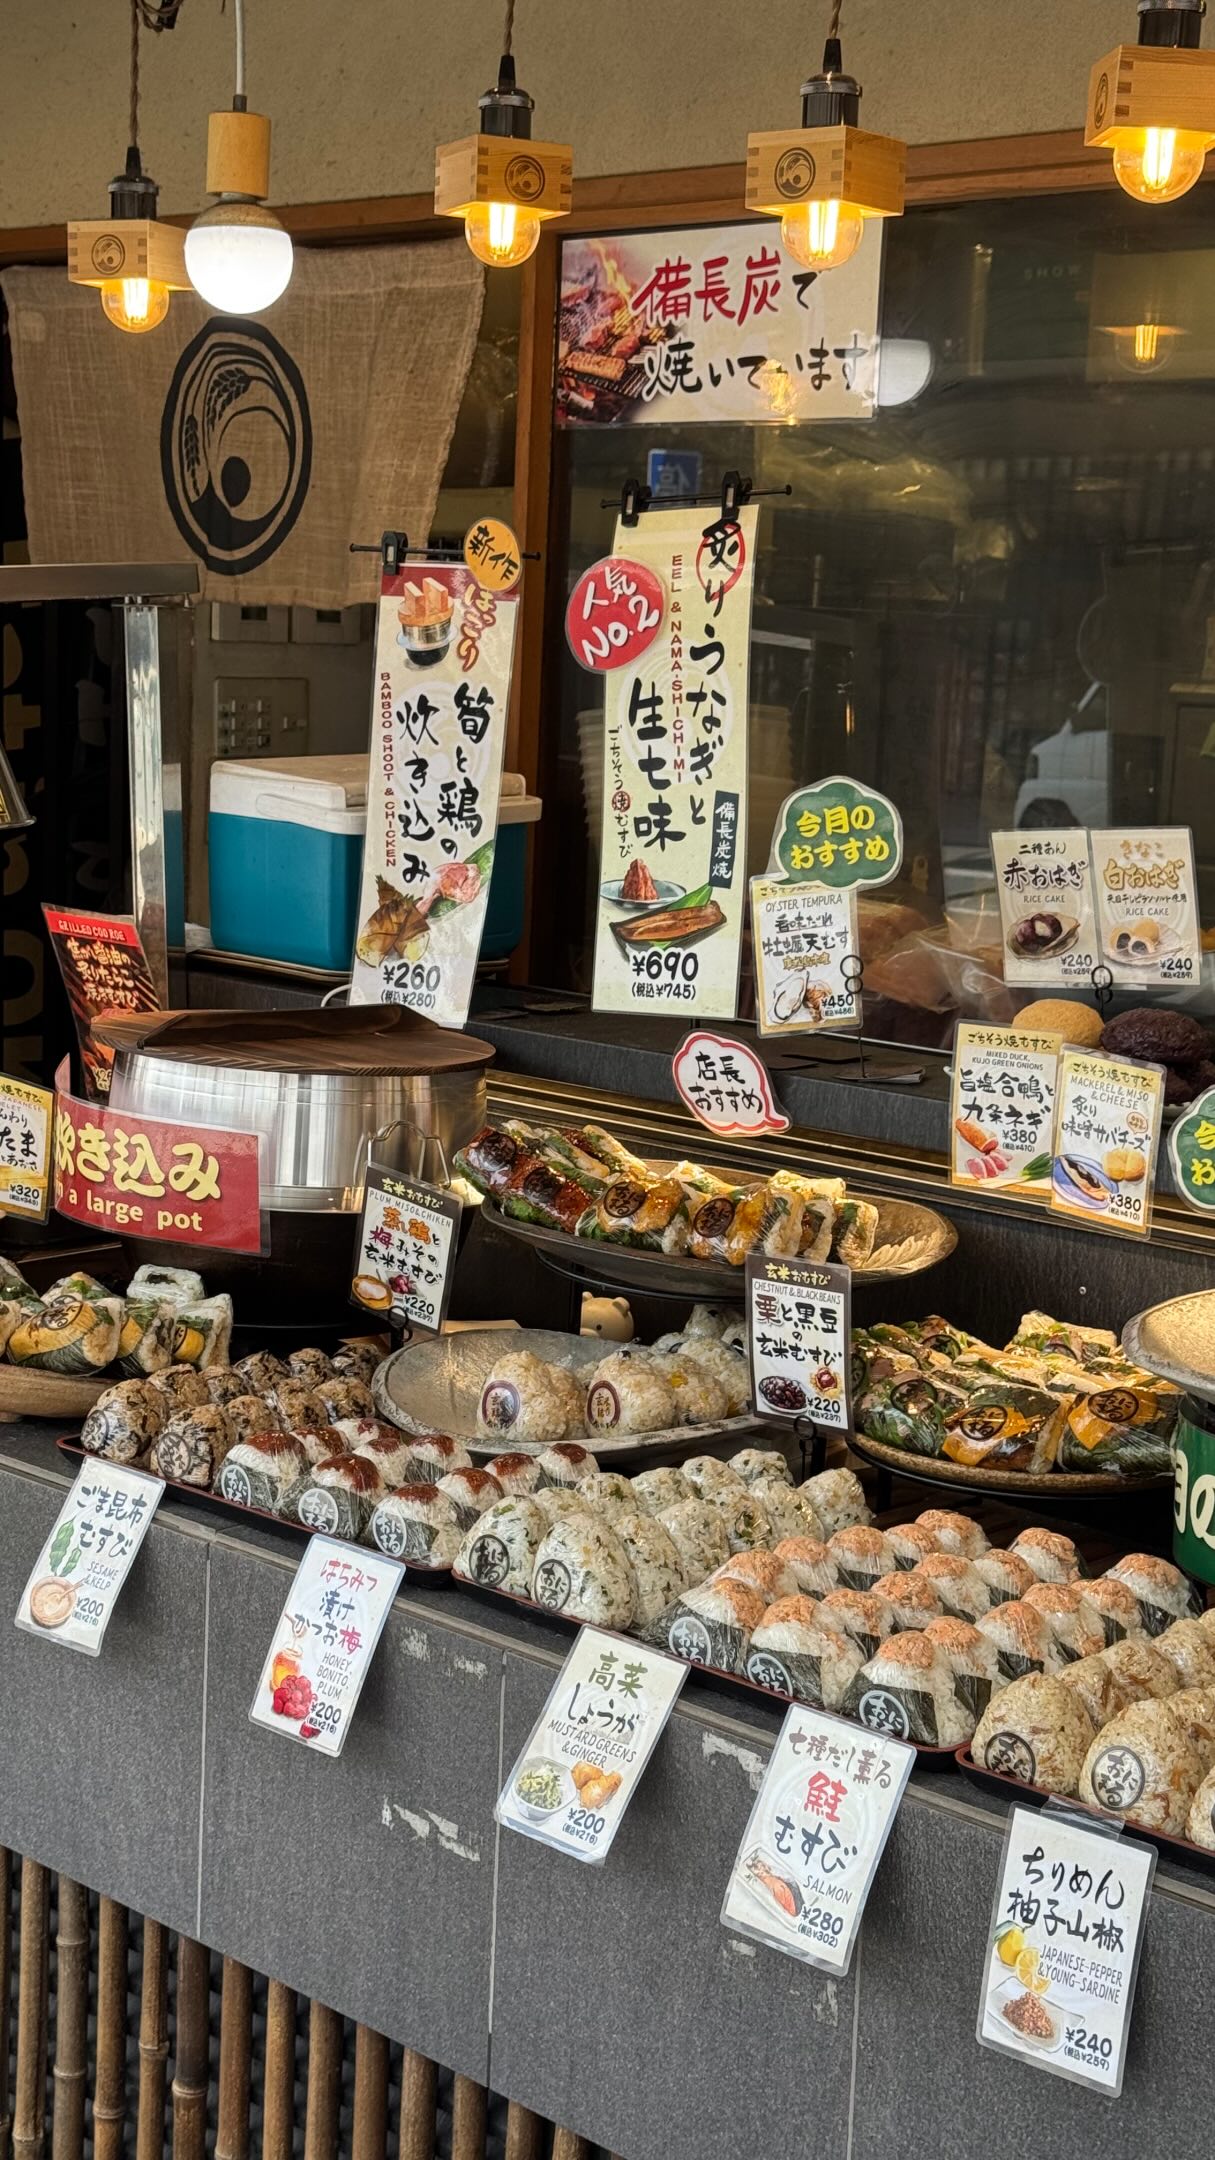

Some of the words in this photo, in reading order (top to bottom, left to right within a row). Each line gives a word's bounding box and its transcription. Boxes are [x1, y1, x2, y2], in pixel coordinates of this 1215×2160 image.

[467, 525, 519, 581] 新作
[671, 554, 683, 593] EEL
[582, 565, 637, 620] 人気
[671, 602, 682, 613] &
[457, 583, 497, 672] ほっこり
[686, 519, 741, 825] 炙りうなぎと
[380, 672, 394, 729] BAMBOO
[671, 620, 685, 783] NAMA-SHICHIMI
[382, 734, 395, 781] SHOOT
[437, 682, 494, 859] 筍と鶏の
[629, 677, 687, 852] 生七味
[384, 787, 395, 796] &
[396, 693, 441, 883] 炊き込み
[384, 801, 397, 867] CHICKEN
[796, 804, 876, 837] 今月の
[712, 801, 736, 880] 備長炭焼
[790, 837, 891, 870] おすすめ
[1018, 842, 1066, 855] 二種あん
[1120, 840, 1164, 859] きなこ
[1002, 858, 1086, 889] 赤おはぎ
[1103, 858, 1185, 890] 白おはぎ
[766, 898, 799, 913] OYSTER
[802, 893, 843, 909] TEMPURA
[1023, 895, 1042, 904] RICE
[1045, 895, 1066, 904] CAKE
[1125, 907, 1145, 917] RICE
[1147, 907, 1169, 916] CAKE
[58, 919, 92, 936] GRILLED
[92, 926, 109, 939] COD
[109, 929, 125, 941] ROE
[76, 960, 135, 988] 炙りたらこ
[382, 961, 441, 992] ¥260
[632, 951, 699, 982] ¥690
[1061, 954, 1093, 968] ¥240
[1160, 958, 1193, 971] ¥240
[631, 982, 697, 1000] (税込¥745)
[821, 994, 854, 1009] ¥450
[695, 1051, 746, 1085] 店長
[972, 1057, 990, 1066] KUJO
[991, 1058, 1016, 1068] GREEN
[1016, 1061, 1043, 1071] ONIONS
[986, 1050, 1008, 1059] MIXED
[688, 1081, 763, 1114] おすすめ
[960, 1068, 1055, 1104] 旨塩合鴨と
[1070, 1075, 1116, 1094] MACKEREL
[1117, 1087, 1125, 1096] &
[1126, 1088, 1149, 1102] MISO
[961, 1096, 1052, 1130] 九条ネギ
[1072, 1095, 1097, 1117] 炙り
[1002, 1129, 1037, 1145] ¥380
[1061, 1115, 1151, 1152] 味噌サバチーズ
[10, 1184, 40, 1200] ¥320
[381, 1177, 444, 1209] 玄米おむすび
[1109, 1193, 1142, 1212] ¥380
[69, 1188, 78, 1205] a
[86, 1189, 144, 1224] large
[157, 1209, 203, 1232] pot
[370, 1225, 440, 1268] 梅みその
[364, 1243, 443, 1285] 玄米むすび
[765, 1262, 832, 1286] 玄米おむすび
[405, 1295, 435, 1315] ¥220
[754, 1281, 789, 1296] CHESTNUT
[789, 1287, 795, 1297] &
[797, 1287, 819, 1301] BLACK
[819, 1292, 841, 1305] BEANS
[755, 1293, 838, 1334] 栗と黒豆
[755, 1332, 842, 1366] 玄米むすび
[792, 1331, 803, 1342] の
[807, 1397, 841, 1413] ¥220
[77, 1485, 148, 1529] ごま昆布
[80, 1519, 134, 1558] むすび
[378, 1533, 400, 1552] まる
[87, 1560, 119, 1581] SESAME
[320, 1557, 378, 1593] はちみつ
[76, 1596, 105, 1617] ¥200
[319, 1588, 356, 1622] 漬け
[294, 1612, 363, 1656] かつお梅
[675, 1622, 705, 1649] おに
[316, 1665, 350, 1690] BONITO,
[321, 1653, 353, 1676] HONEY,
[588, 1650, 649, 1700] 高菜
[751, 1657, 784, 1683] おに
[317, 1681, 342, 1701] PLUM
[310, 1701, 343, 1724] ¥200
[567, 1682, 640, 1734] しょうが
[548, 1719, 596, 1747] MUSTARD
[597, 1738, 637, 1764] GREENS
[789, 1727, 893, 1789] 七種だし薫る
[803, 1770, 848, 1823] 鮭
[562, 1822, 598, 1846] (税込¥216)
[567, 1807, 605, 1834] ¥200
[774, 1815, 858, 1874] むすび
[802, 1874, 853, 1905] SALMON
[1022, 1845, 1125, 1910] ちりめん
[801, 1904, 844, 1936] ¥280
[1006, 1887, 1125, 1953] 柚子山椒
[797, 1924, 838, 1949] (税込¥302)
[1039, 1943, 1122, 1988] JAPANESE-PEPPER
[1064, 2026, 1113, 2058] ¥240
[1063, 2046, 1110, 2071] (税込¥259)
